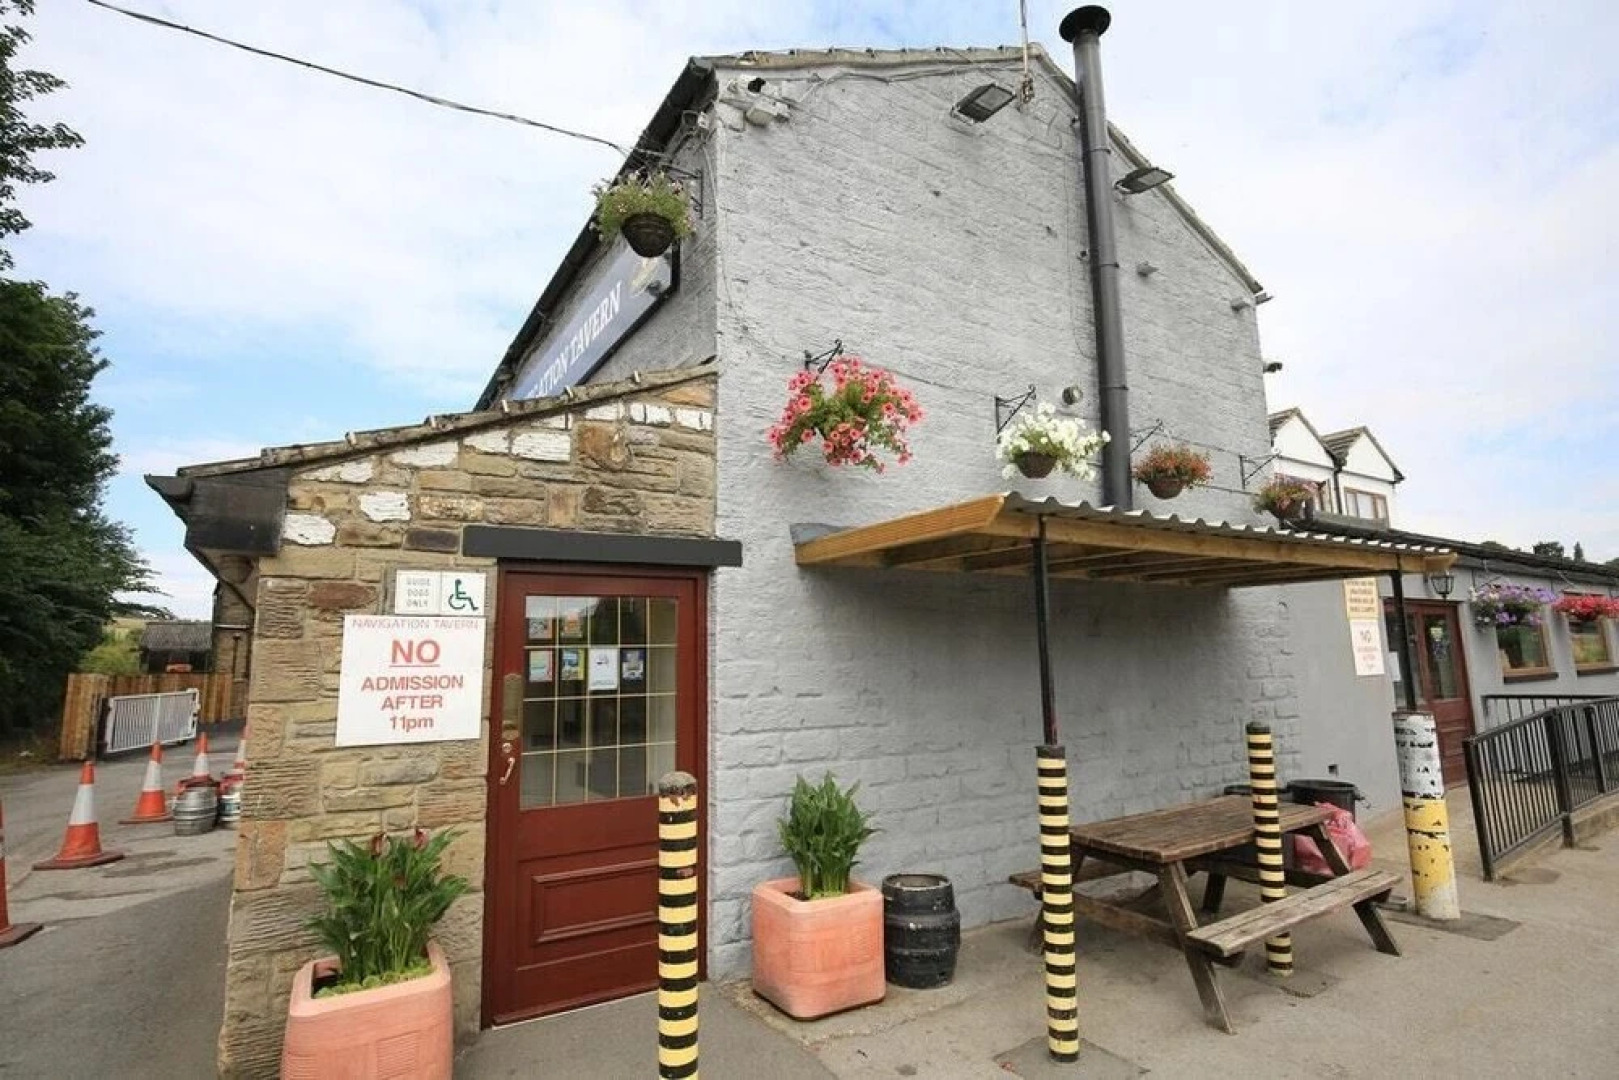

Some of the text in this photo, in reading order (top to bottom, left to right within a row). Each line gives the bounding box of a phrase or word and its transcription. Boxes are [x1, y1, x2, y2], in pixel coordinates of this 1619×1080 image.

[568, 281, 622, 367] TAVERN
[352, 618, 479, 630] NAVIGATION TAVERN
[390, 638, 441, 664] NO
[360, 674, 464, 692] ADMISSION
[380, 695, 443, 711] AFTER
[389, 715, 435, 733] 11pm
